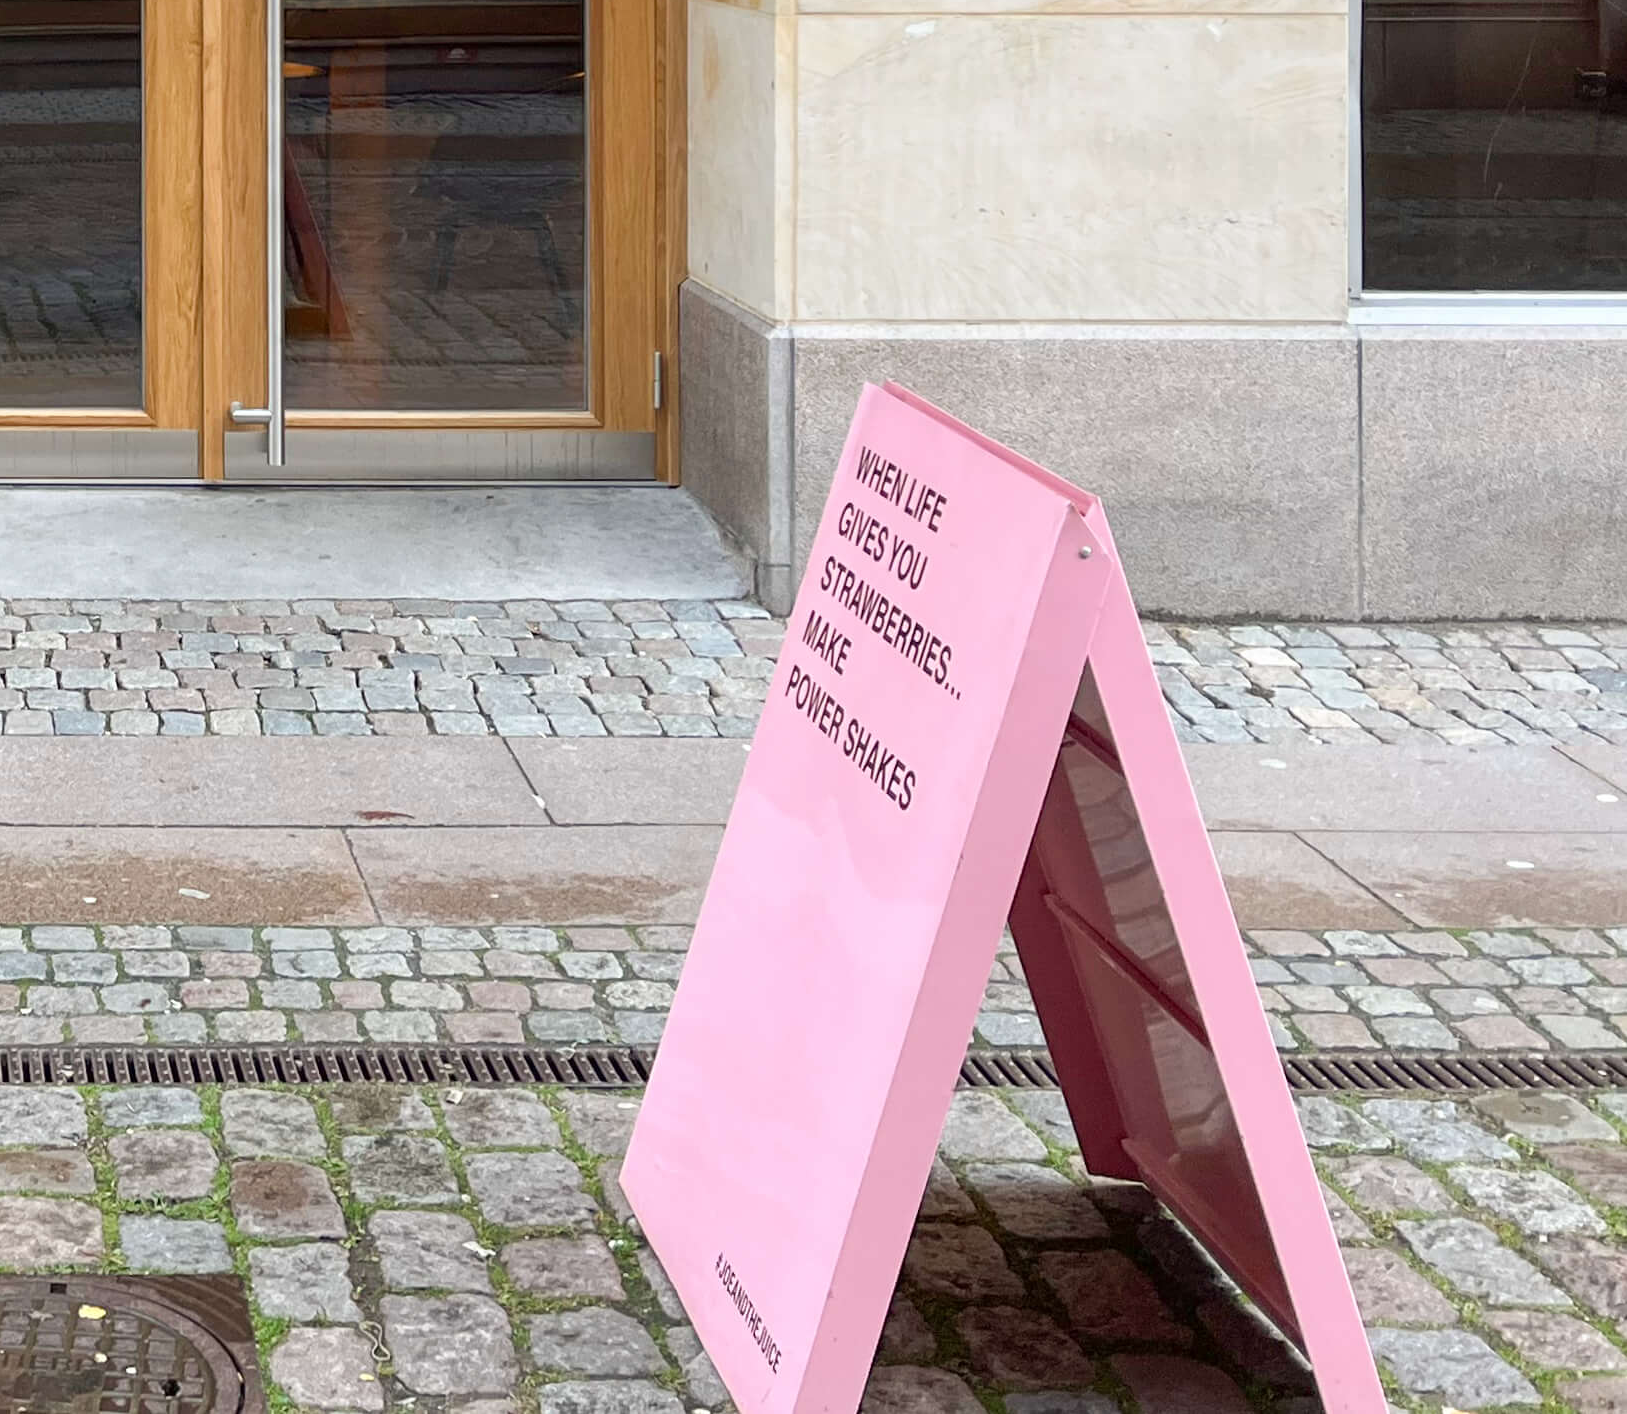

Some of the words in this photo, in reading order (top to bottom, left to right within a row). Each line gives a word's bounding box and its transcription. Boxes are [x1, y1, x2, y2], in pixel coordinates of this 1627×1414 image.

[856, 445, 906, 508] WHEN
[904, 479, 947, 534] LIFE
[838, 501, 889, 563] GIVES
[887, 534, 928, 591] YOU
[802, 609, 852, 676] MAKE
[820, 555, 962, 701] STRAWBERRIES...
[784, 664, 845, 745] POWER
[842, 717, 916, 812] SHAKES
